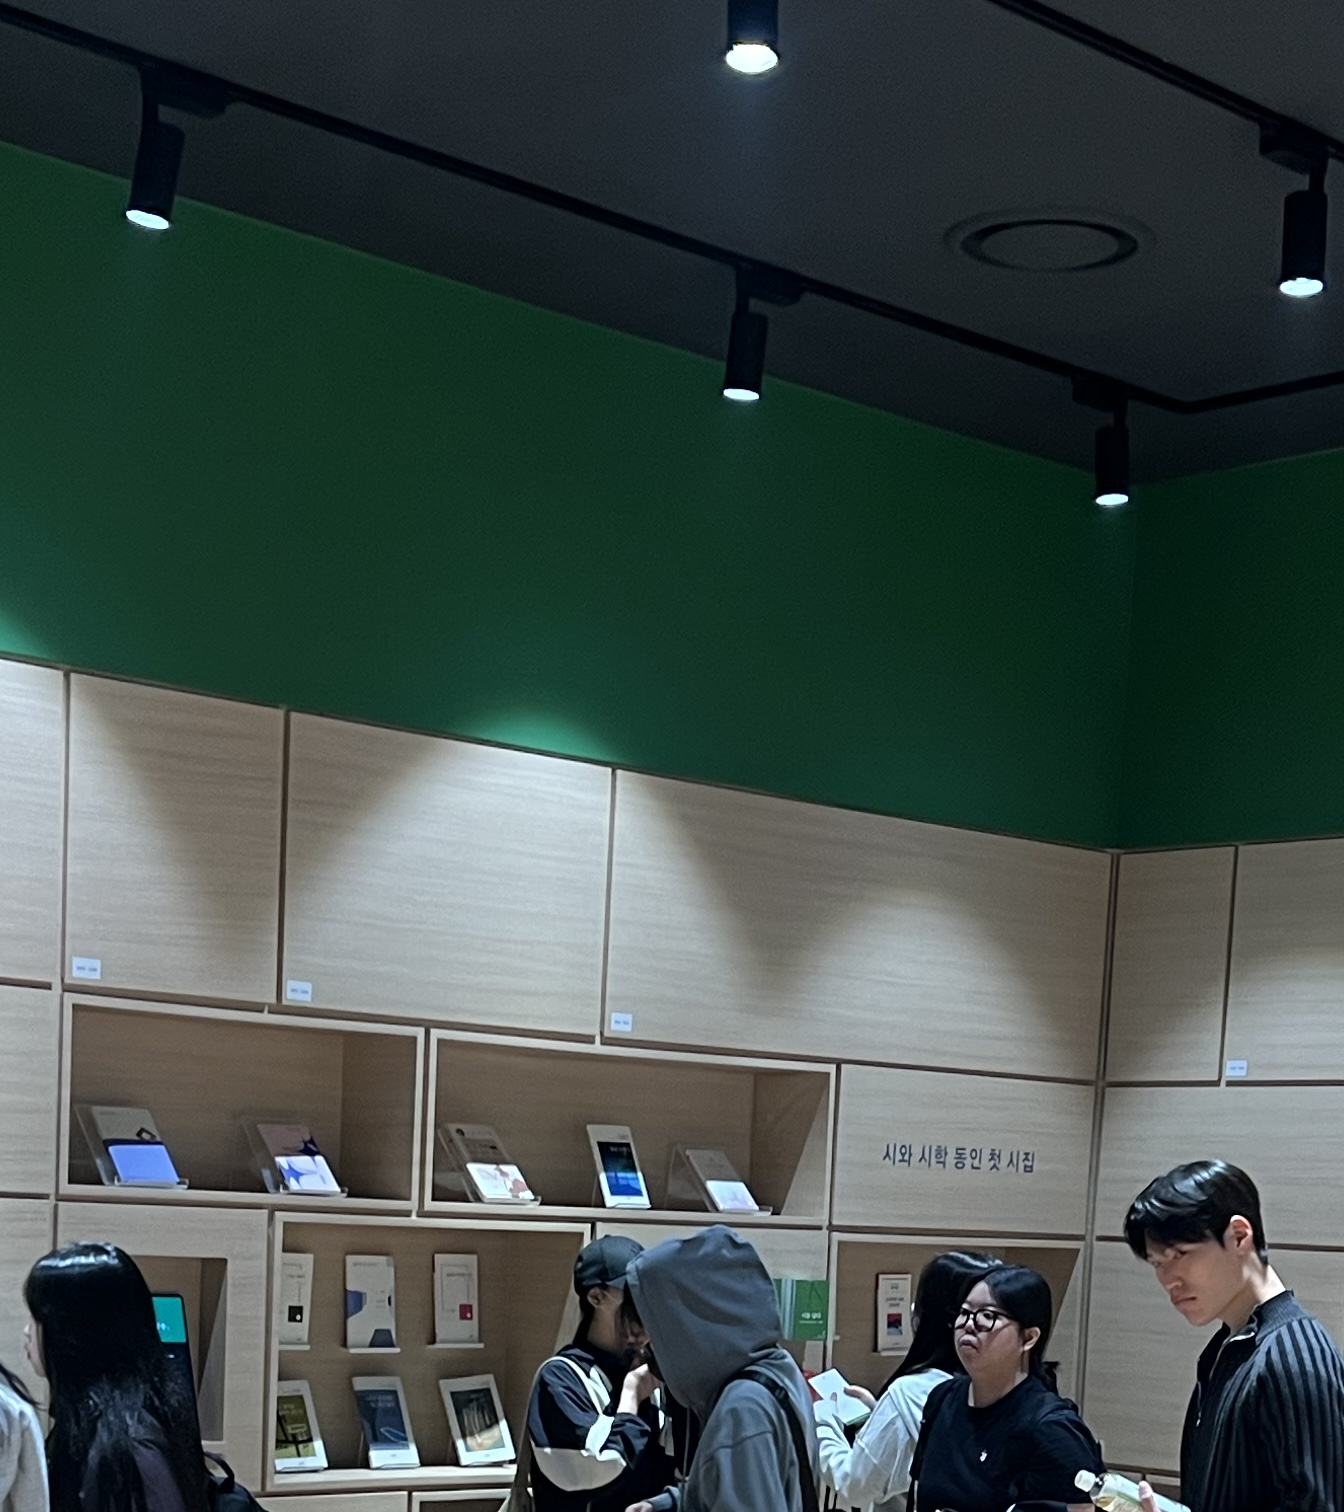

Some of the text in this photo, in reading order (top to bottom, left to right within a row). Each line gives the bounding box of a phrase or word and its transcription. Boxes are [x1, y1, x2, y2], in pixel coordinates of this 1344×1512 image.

[882, 1142, 1036, 1174] 시와 시학 동인 첫 시집
